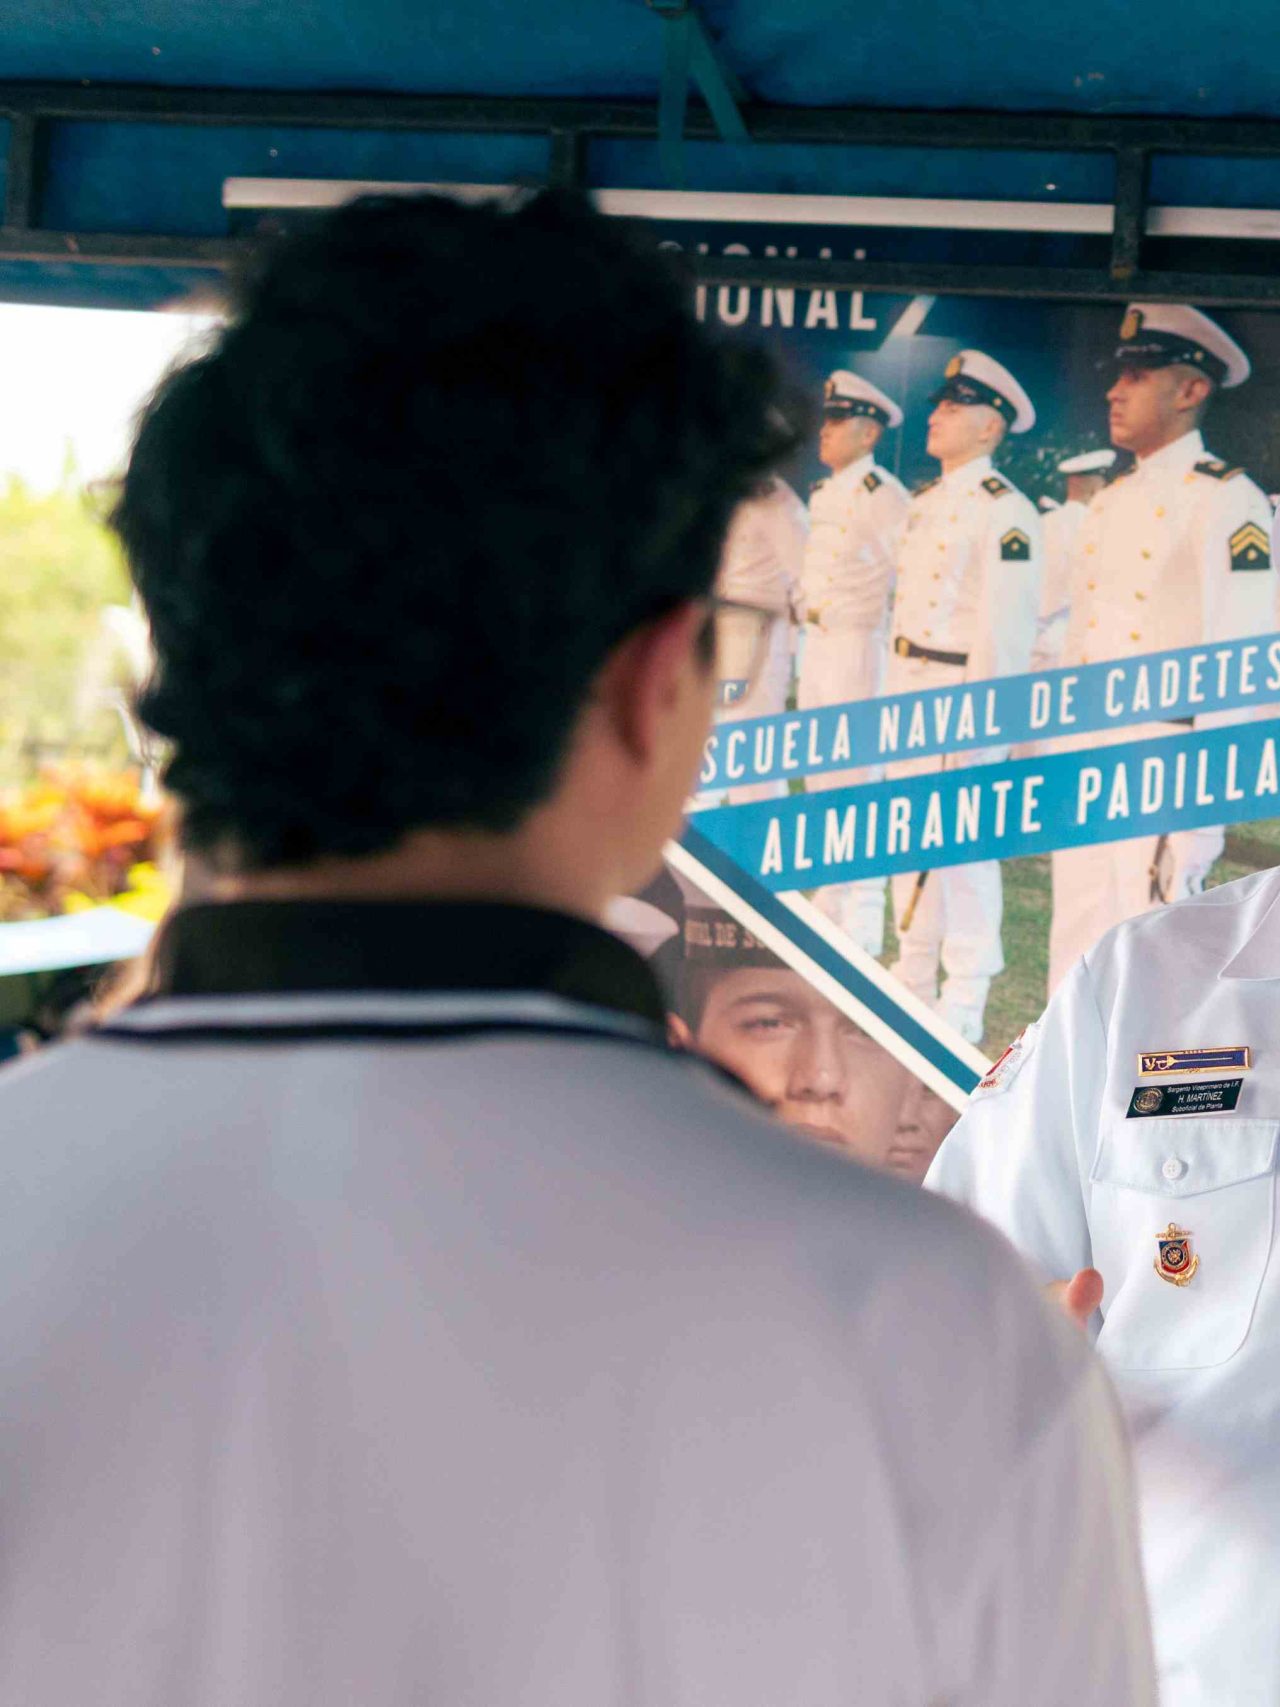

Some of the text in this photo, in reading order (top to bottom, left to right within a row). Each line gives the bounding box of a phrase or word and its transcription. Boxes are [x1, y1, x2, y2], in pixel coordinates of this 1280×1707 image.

[656, 239, 877, 331] IONAL
[700, 713, 851, 784] SCUELA
[878, 688, 1001, 754] NAVAL
[1029, 676, 1079, 730] DE
[760, 738, 1279, 875] ALMIRANTE PADILLA
[1171, 1105, 1198, 1113] Suboficial
[1192, 1083, 1222, 1091] Viceprimero
